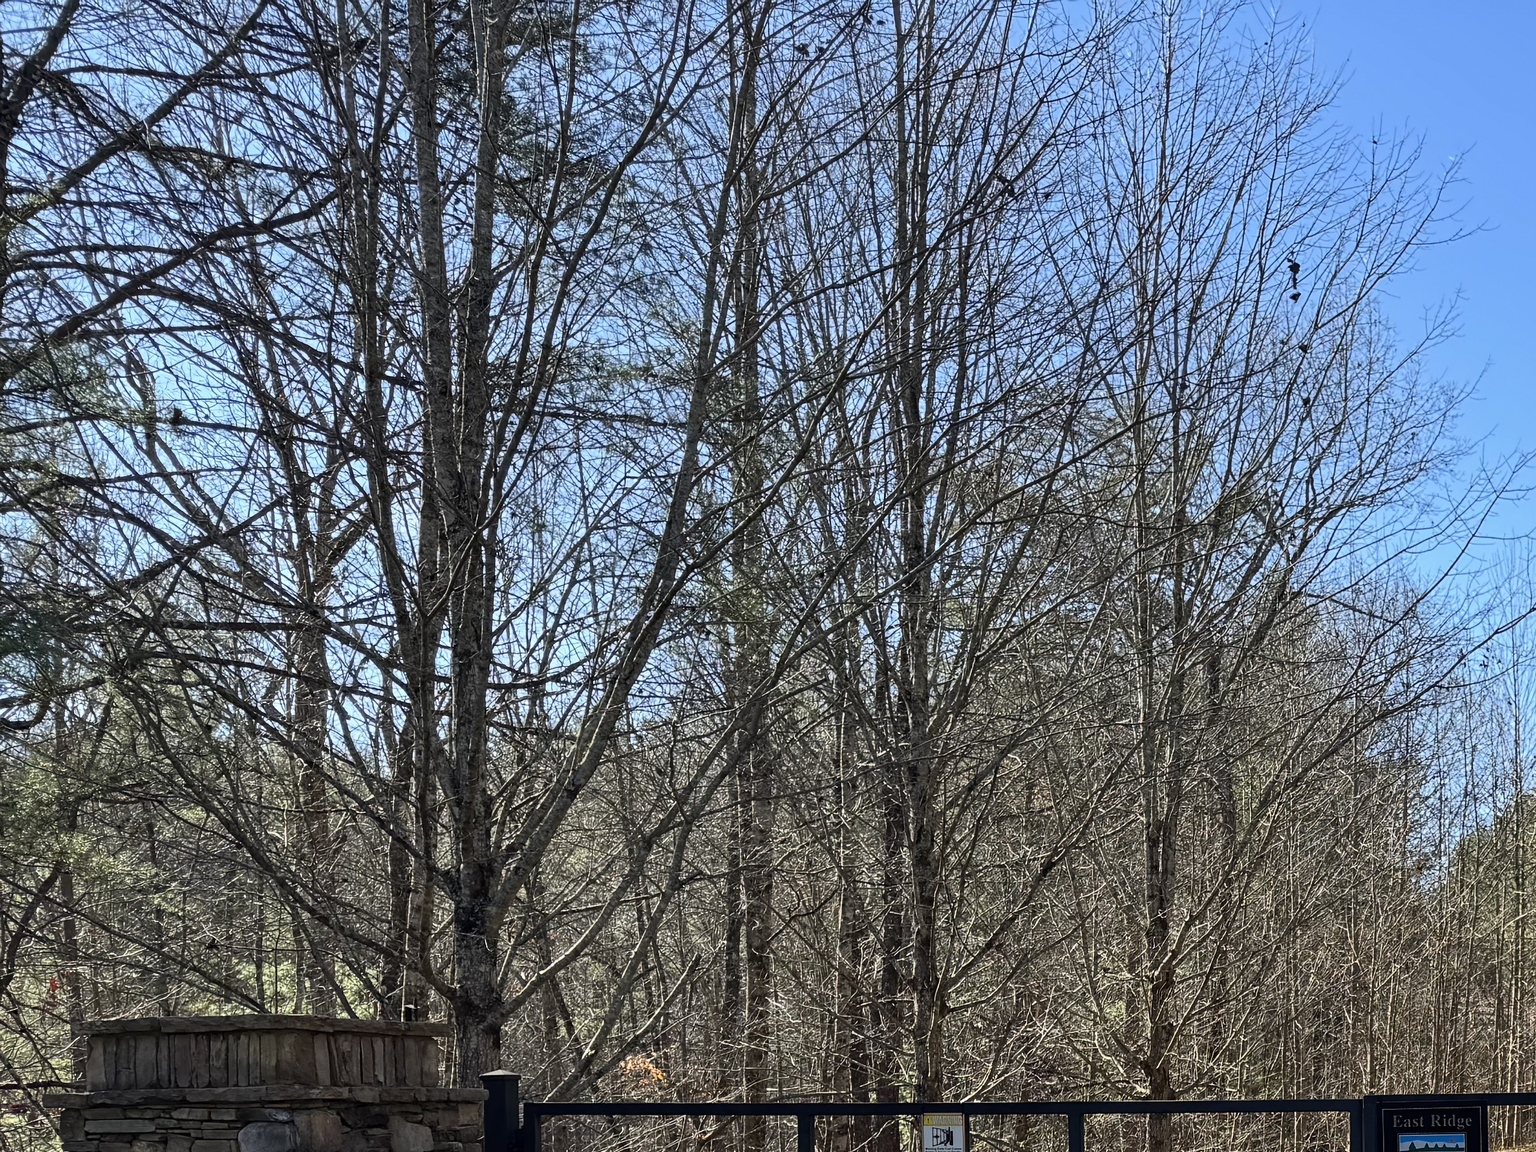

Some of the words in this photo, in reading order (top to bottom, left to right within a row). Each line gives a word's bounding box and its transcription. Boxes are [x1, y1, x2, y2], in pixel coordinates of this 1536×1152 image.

[933, 1116, 962, 1125] WARNING
[1393, 1115, 1424, 1128] East
[1431, 1114, 1473, 1130] Ridge
